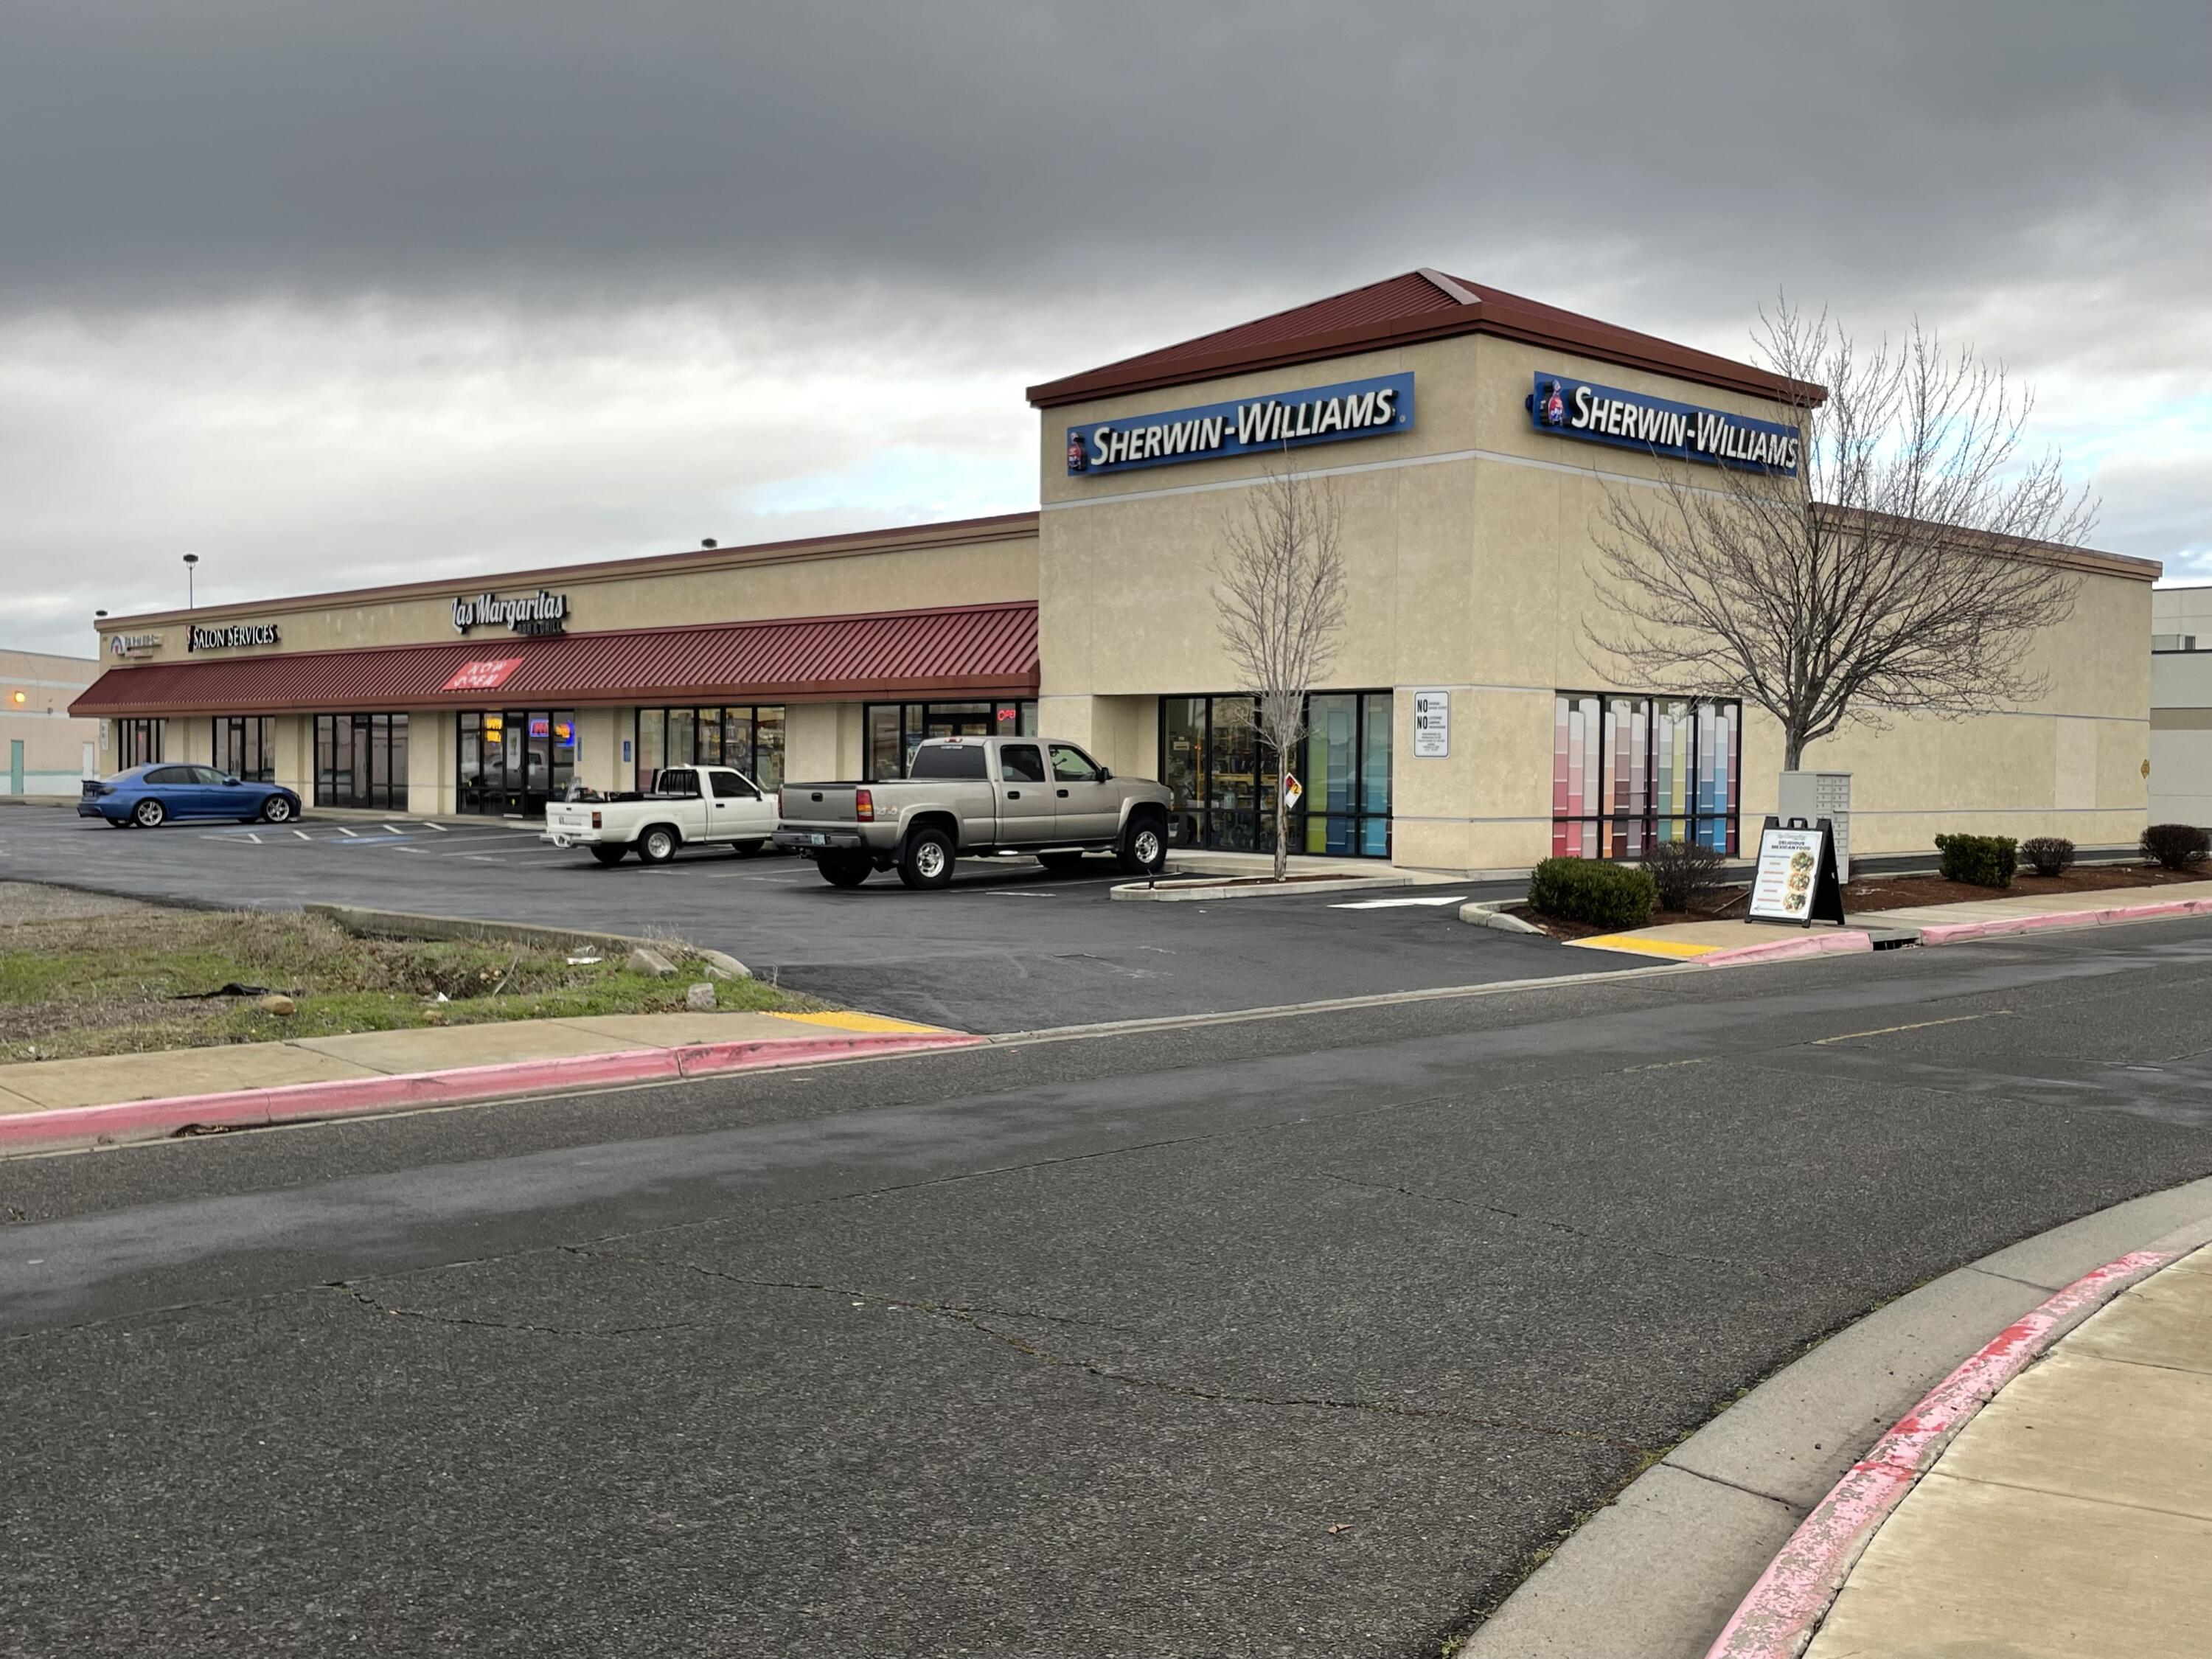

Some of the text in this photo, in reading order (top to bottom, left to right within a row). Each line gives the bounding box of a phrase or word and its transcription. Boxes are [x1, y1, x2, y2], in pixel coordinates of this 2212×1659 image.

[1091, 389, 1394, 466] SHERWIN-WILLIAMS
[1571, 386, 1799, 469] SHERWIN-WILLIAMS
[451, 591, 563, 634] Las Margaritas
[193, 628, 224, 649] SALON
[228, 625, 274, 647] SERVICES
[467, 661, 507, 675] NOW
[453, 675, 498, 686] OPEN
[1417, 699, 1427, 713] NO
[1416, 716, 1427, 729] NO
[1293, 784, 1298, 794] 2
